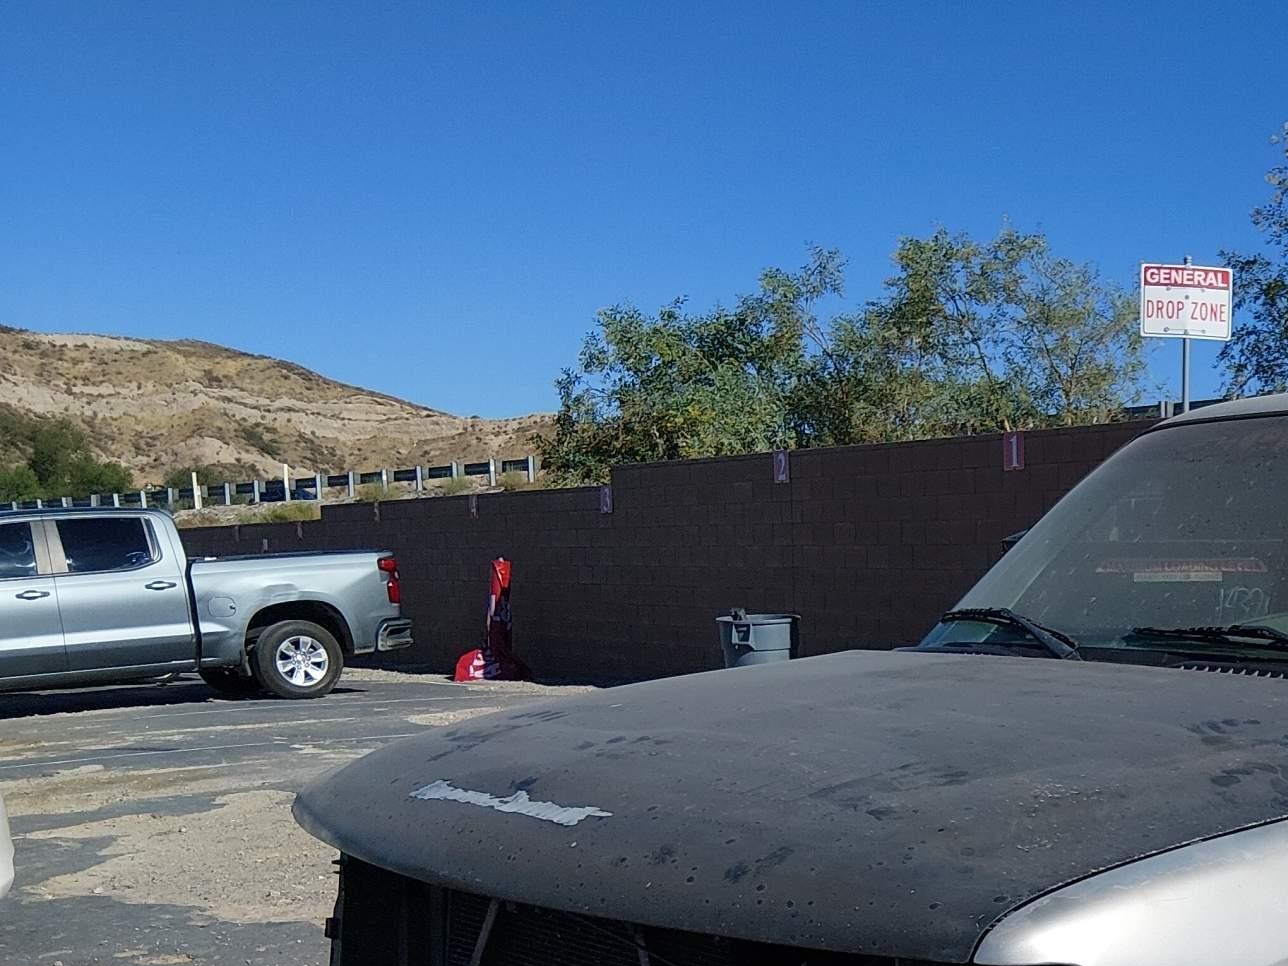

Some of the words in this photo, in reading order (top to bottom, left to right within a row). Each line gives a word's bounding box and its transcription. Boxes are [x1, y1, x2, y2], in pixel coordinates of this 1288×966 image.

[1145, 268, 1228, 288] GENERAL
[1146, 300, 1185, 320] DROP
[1190, 302, 1227, 323] ZONE
[1009, 434, 1020, 467] 1
